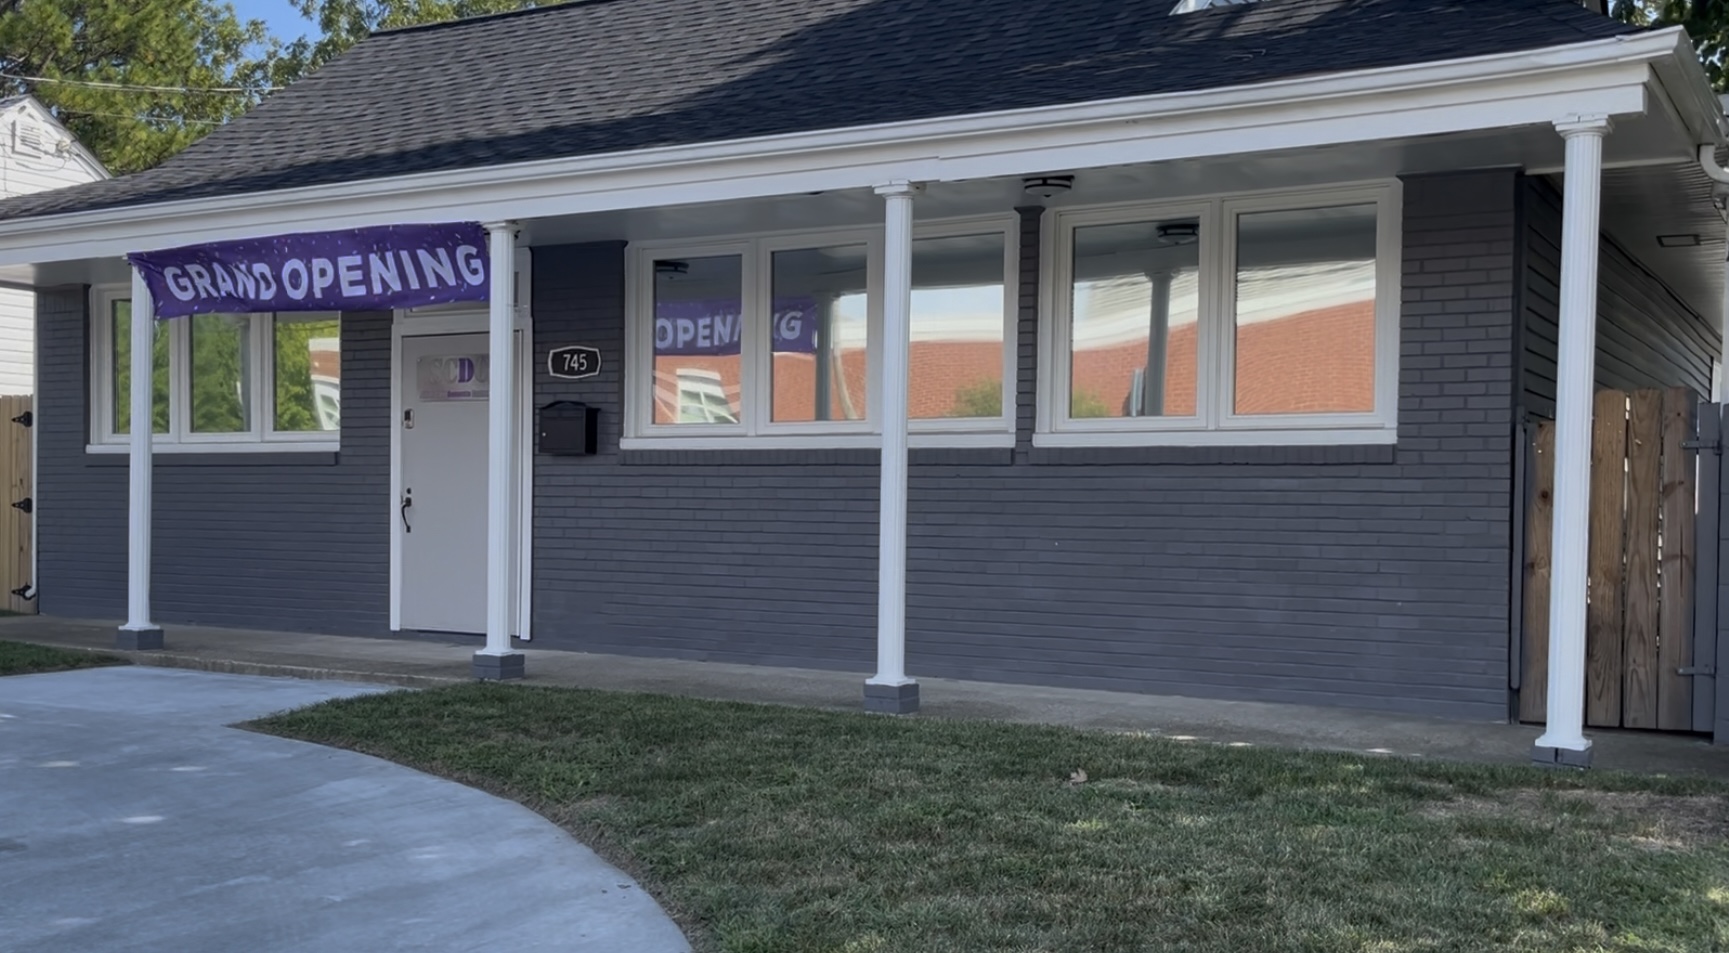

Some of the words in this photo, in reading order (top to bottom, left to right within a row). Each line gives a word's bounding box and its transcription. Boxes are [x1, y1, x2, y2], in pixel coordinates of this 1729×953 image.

[164, 262, 277, 301] GRAND
[282, 245, 485, 300] OPENING
[563, 353, 587, 371] 745
